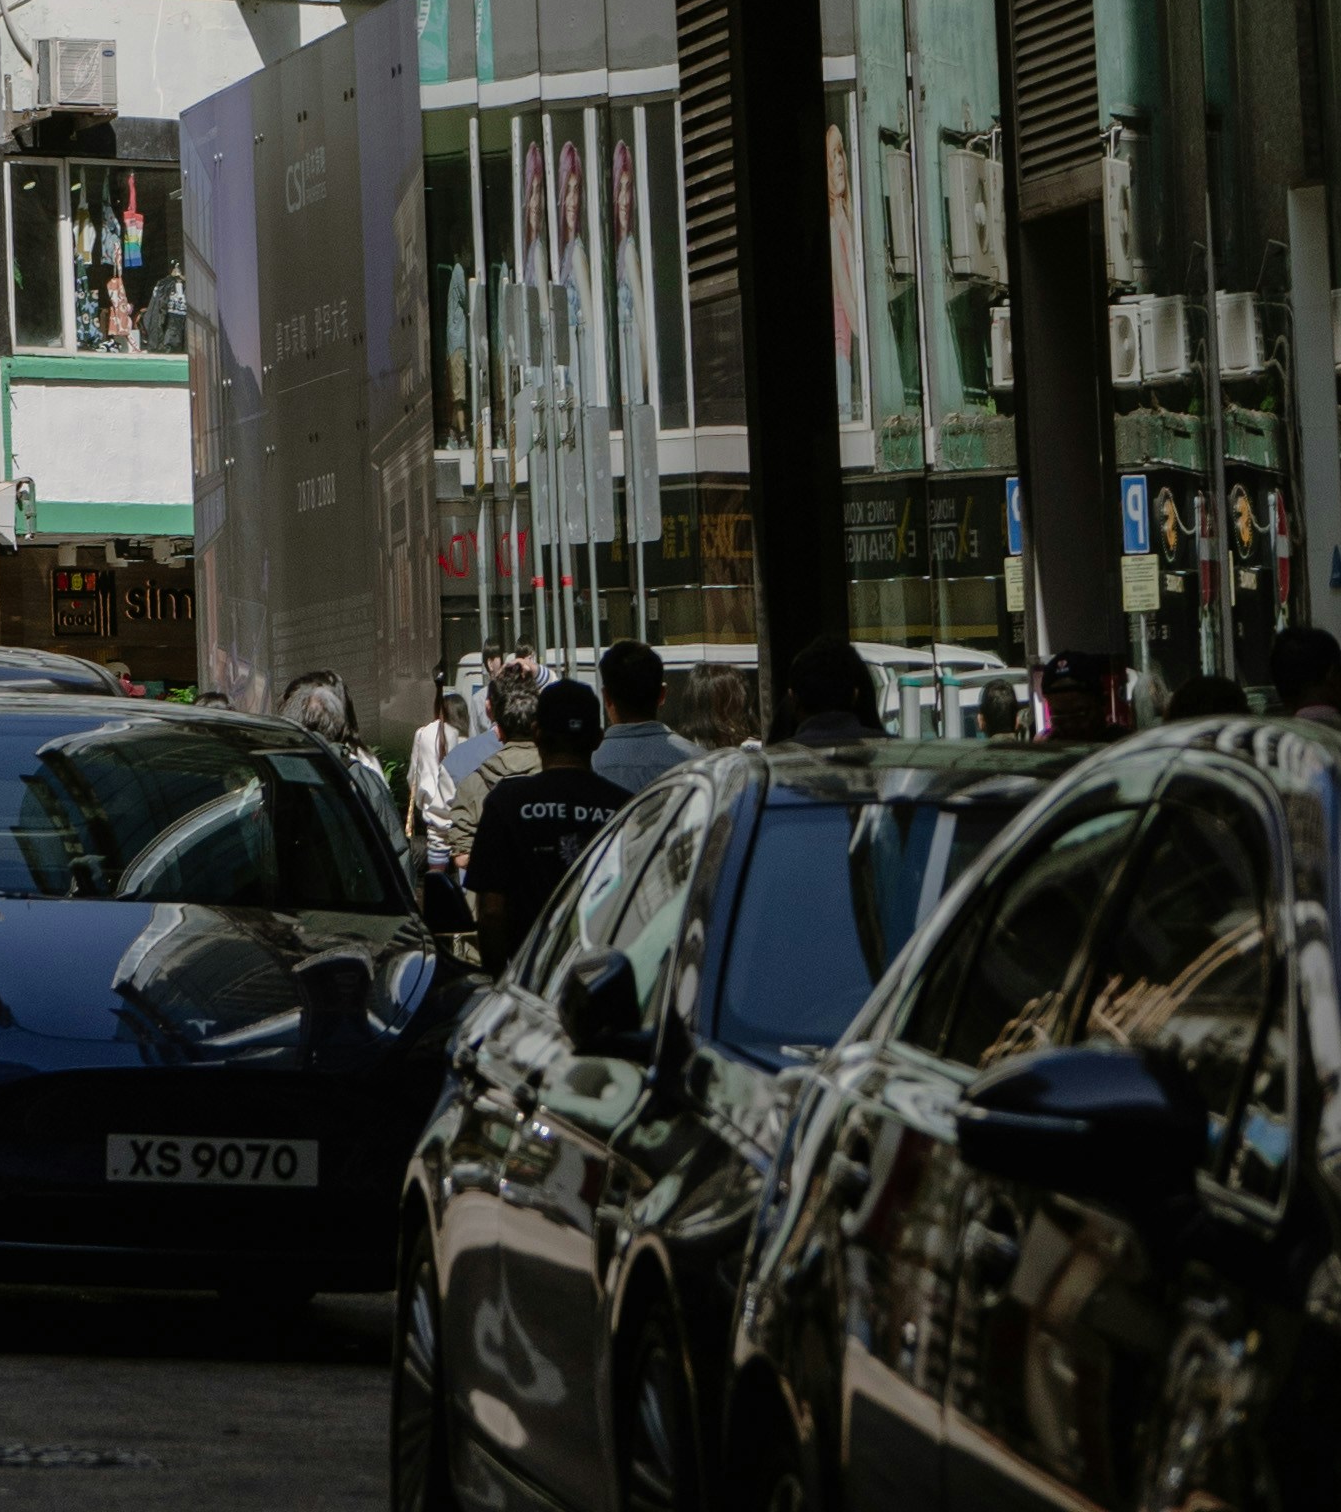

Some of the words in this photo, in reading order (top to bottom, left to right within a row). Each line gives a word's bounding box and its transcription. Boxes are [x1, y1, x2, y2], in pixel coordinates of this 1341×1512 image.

[520, 802, 567, 820] COTE
[129, 1140, 182, 1179] XS
[190, 1143, 299, 1184] 9070
